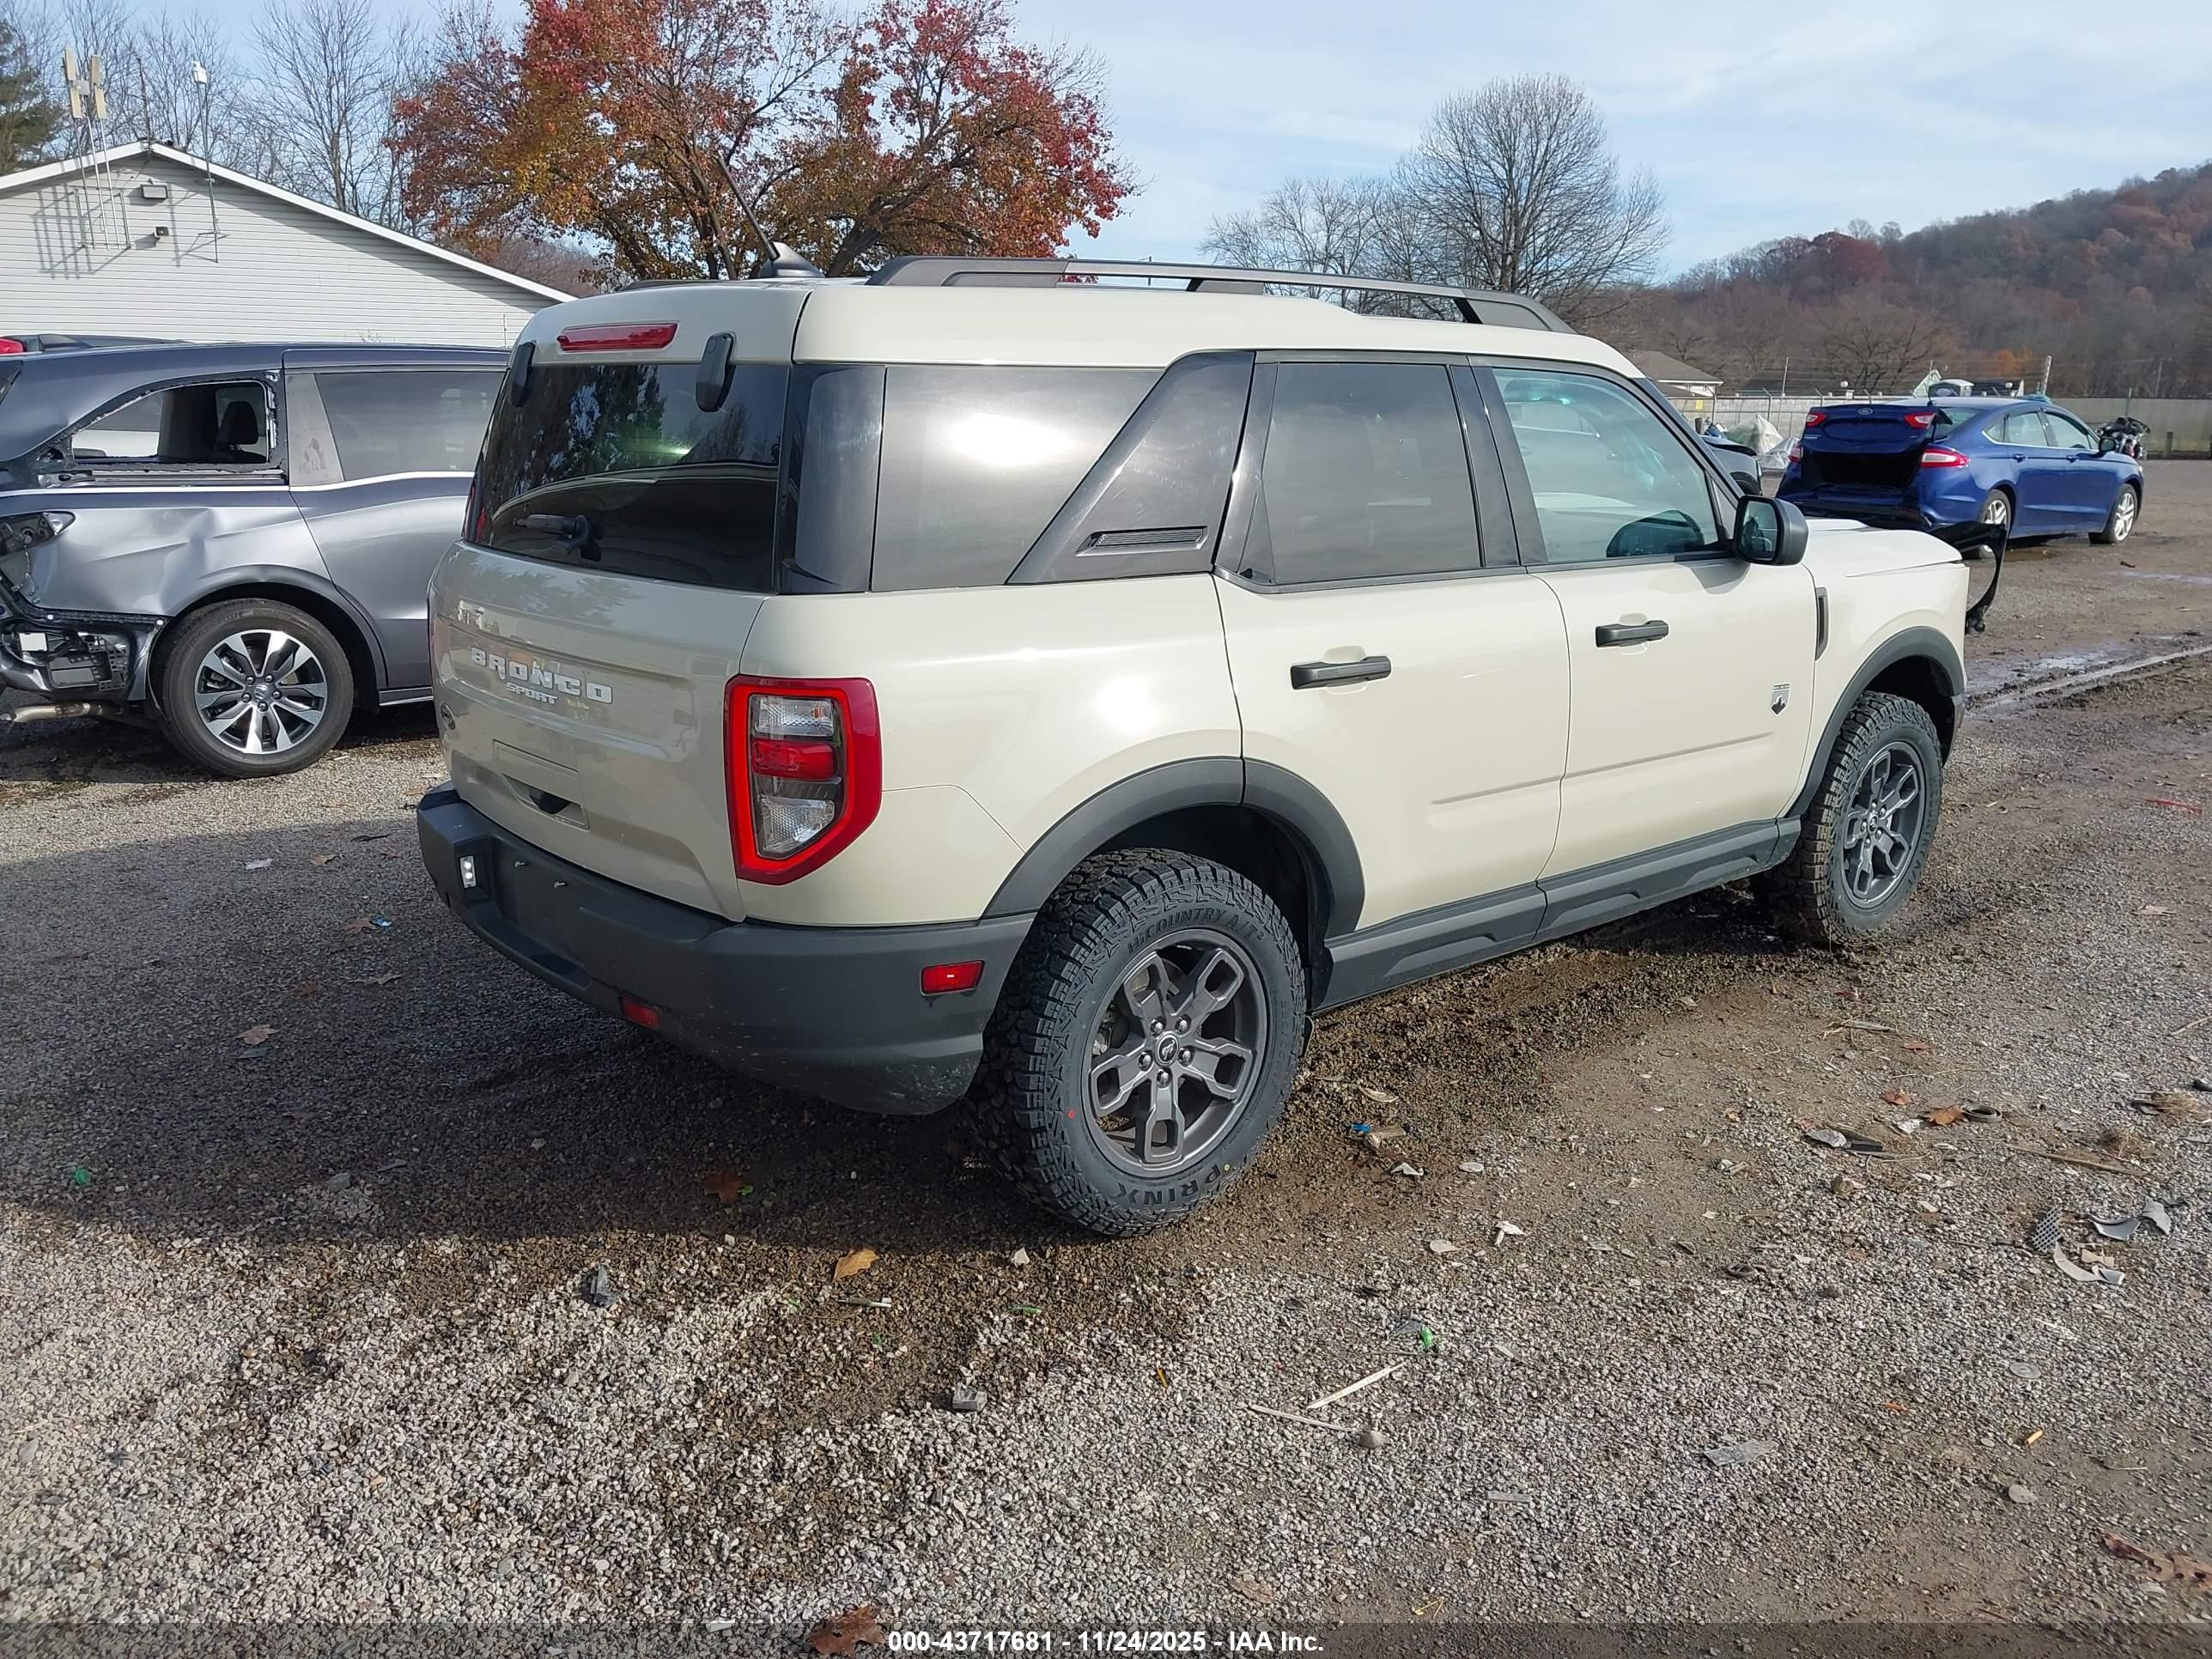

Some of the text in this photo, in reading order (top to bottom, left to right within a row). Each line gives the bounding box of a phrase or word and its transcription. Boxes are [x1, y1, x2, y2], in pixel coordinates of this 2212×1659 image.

[471, 646, 613, 704] BRONCO
[506, 681, 558, 705] SPORT
[1109, 1164, 1222, 1205] PRINX
